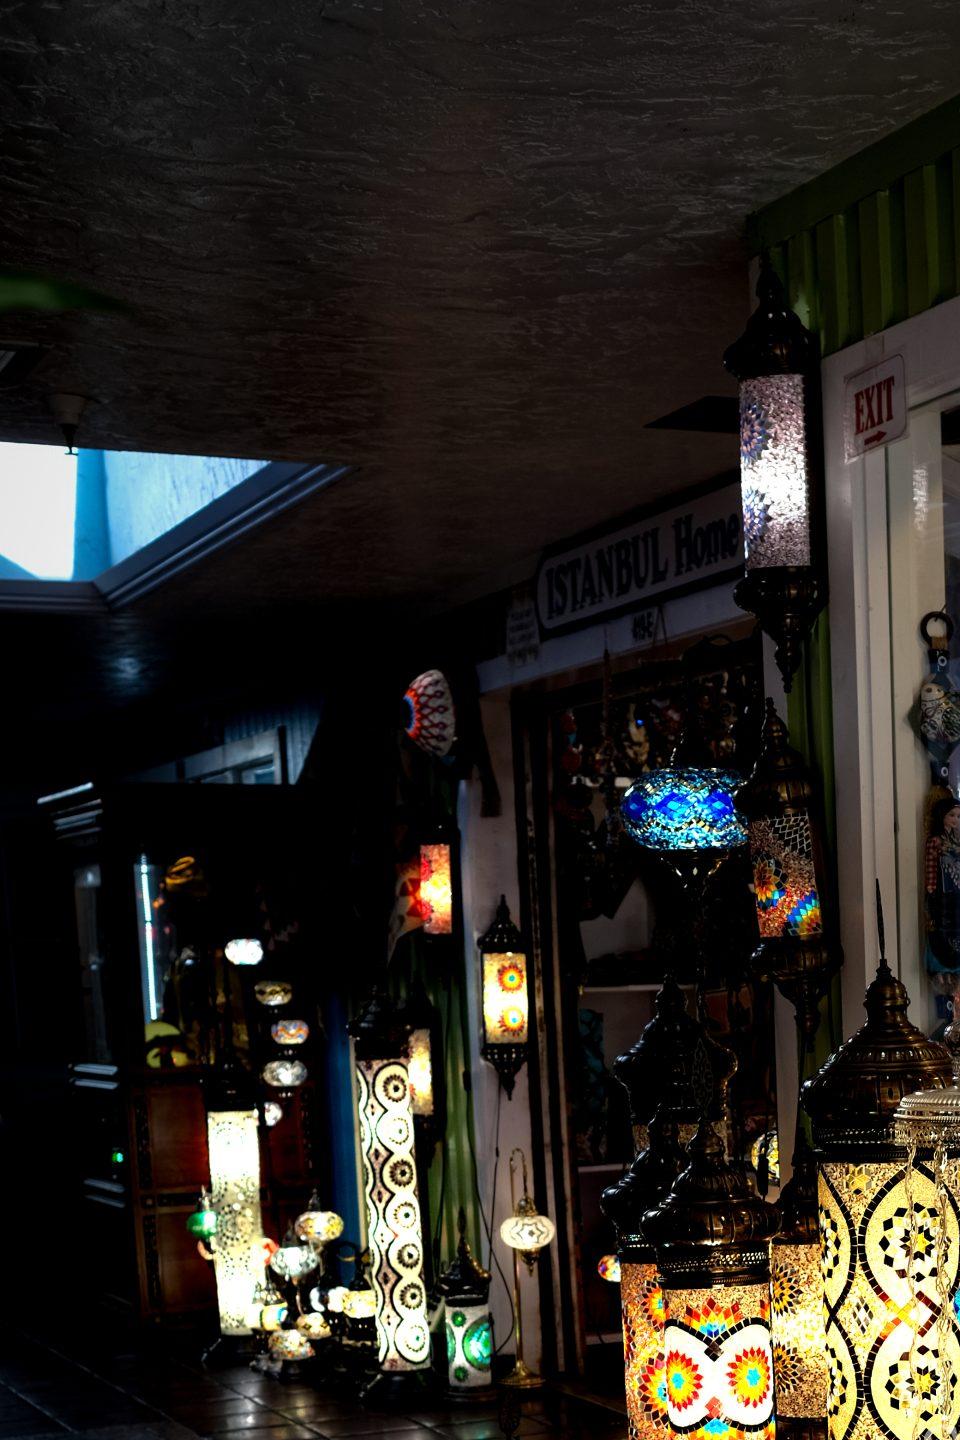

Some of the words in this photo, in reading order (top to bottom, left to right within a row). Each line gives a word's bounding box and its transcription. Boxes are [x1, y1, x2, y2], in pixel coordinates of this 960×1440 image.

[854, 375, 895, 436] EXIT
[545, 526, 669, 621] ISTANBUL
[673, 512, 740, 577] Home
